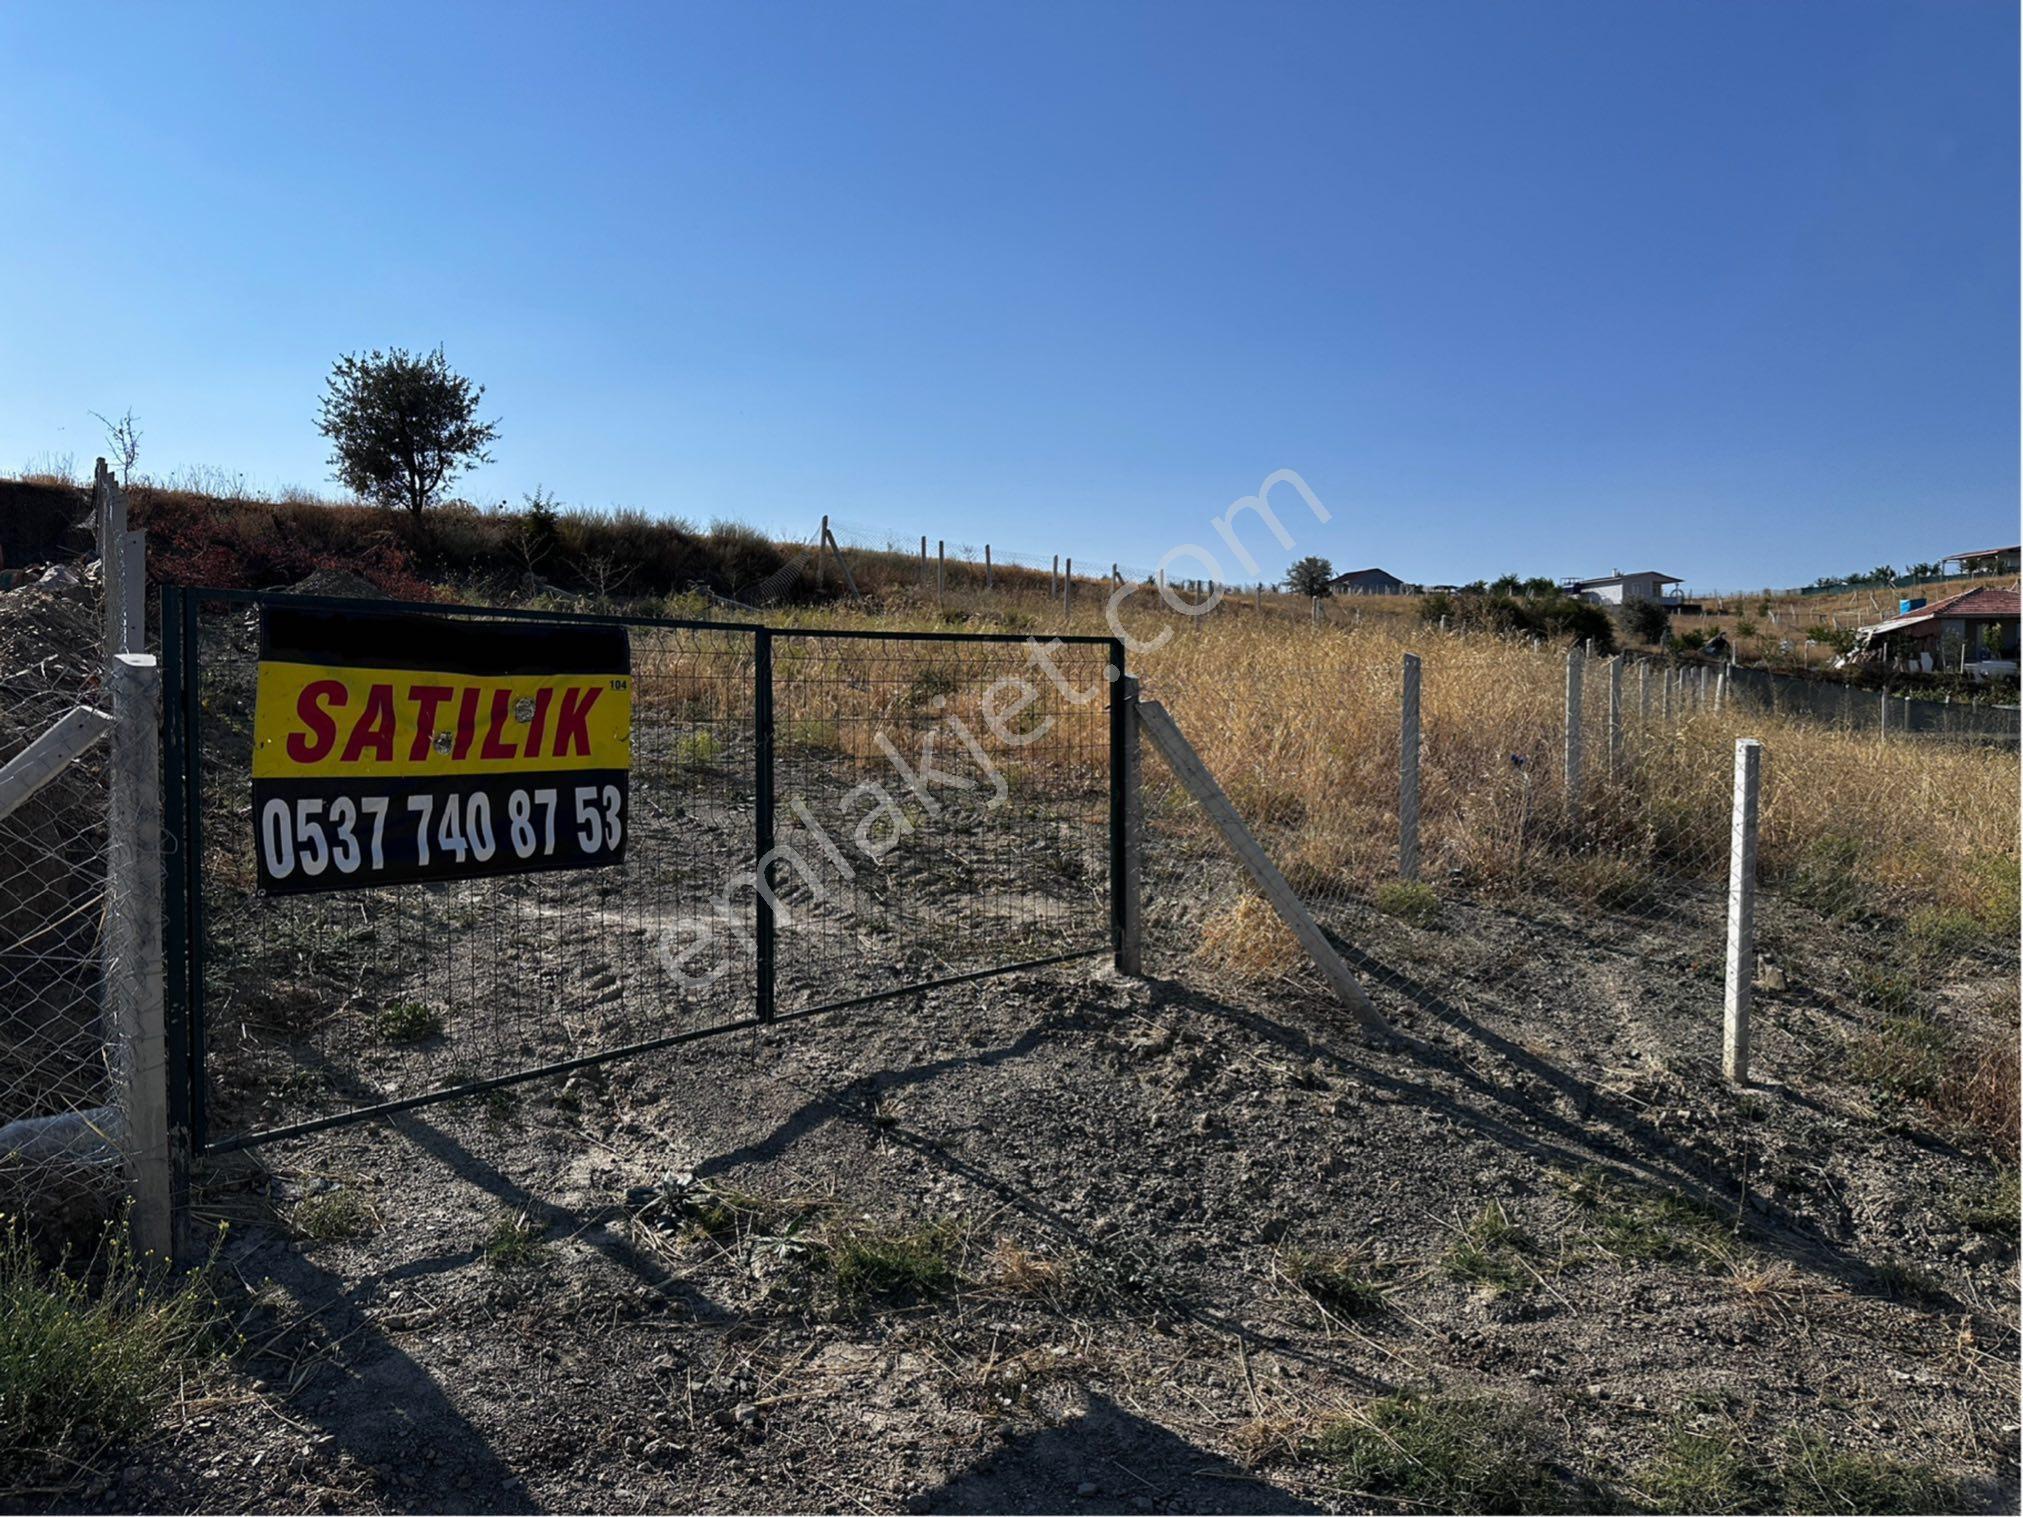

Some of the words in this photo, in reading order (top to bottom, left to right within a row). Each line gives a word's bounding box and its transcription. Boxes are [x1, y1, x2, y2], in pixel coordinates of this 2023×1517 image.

[286, 679, 604, 764] SATILIK
[609, 679, 627, 690] 104
[262, 796, 390, 879] 0537
[407, 791, 496, 866] 740
[508, 788, 558, 859] 87
[575, 784, 622, 854] 53
